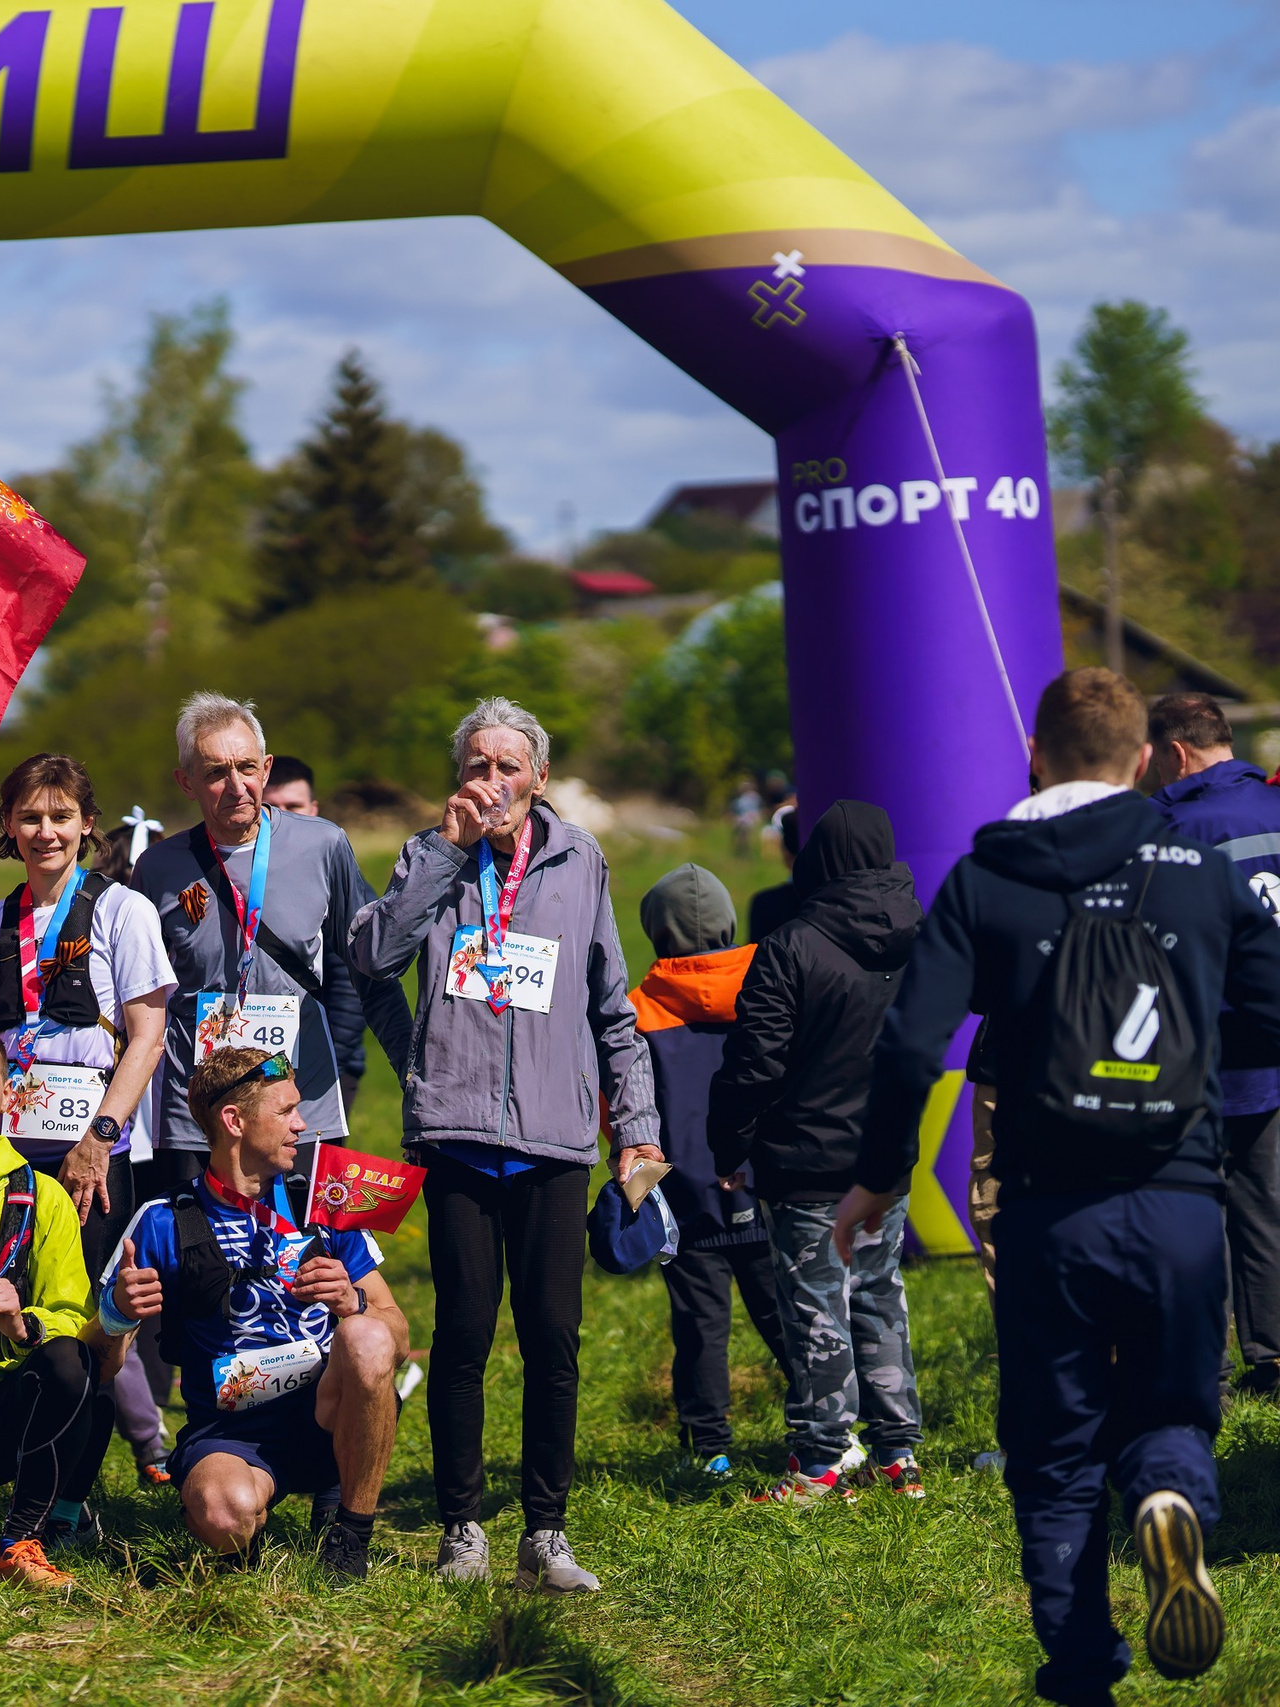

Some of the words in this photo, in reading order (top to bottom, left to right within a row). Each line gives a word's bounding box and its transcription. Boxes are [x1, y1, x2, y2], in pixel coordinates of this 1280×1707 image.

[792, 457, 848, 486] PRO
[795, 477, 978, 534] СПОРТ
[986, 476, 1041, 519] 40
[503, 942, 525, 951] ПОРТ
[253, 1026, 285, 1045] 48
[47, 1076, 72, 1084] СПОРТ
[59, 1098, 90, 1119] 83
[41, 1120, 79, 1132] Юлия
[345, 1164, 361, 1179] 9
[361, 1169, 406, 1189] МАЯ
[260, 1355, 285, 1366] СПОРТ
[271, 1371, 312, 1393] 165
